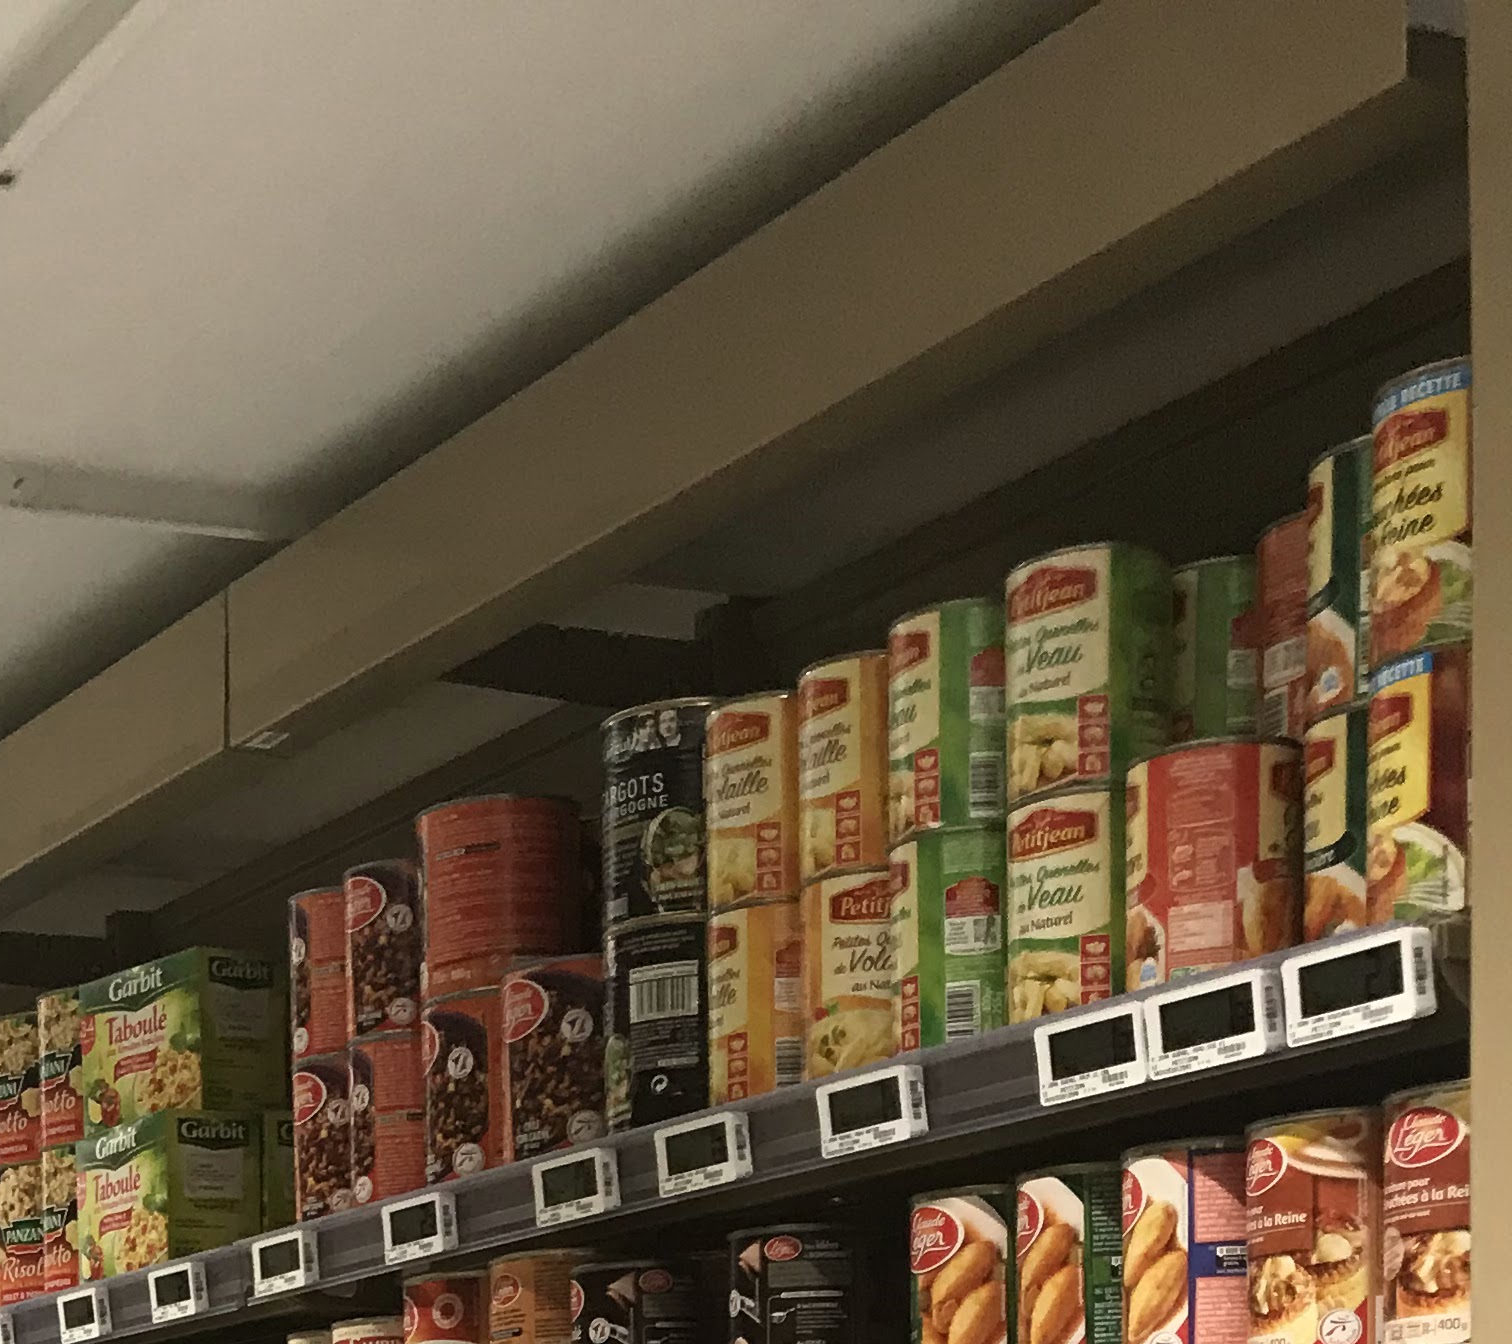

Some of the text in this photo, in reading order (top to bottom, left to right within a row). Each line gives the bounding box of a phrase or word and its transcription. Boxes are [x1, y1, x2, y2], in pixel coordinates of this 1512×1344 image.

[1027, 882, 1085, 909] Veau
[109, 966, 164, 1003] Garbit
[105, 1005, 168, 1045] Taboulé
[96, 1126, 138, 1160] Garbit
[1394, 1126, 1454, 1161] Léger
[92, 1164, 141, 1203] Taboulé
[1431, 1190, 1445, 1203] la
[1274, 1211, 1308, 1226] Reine
